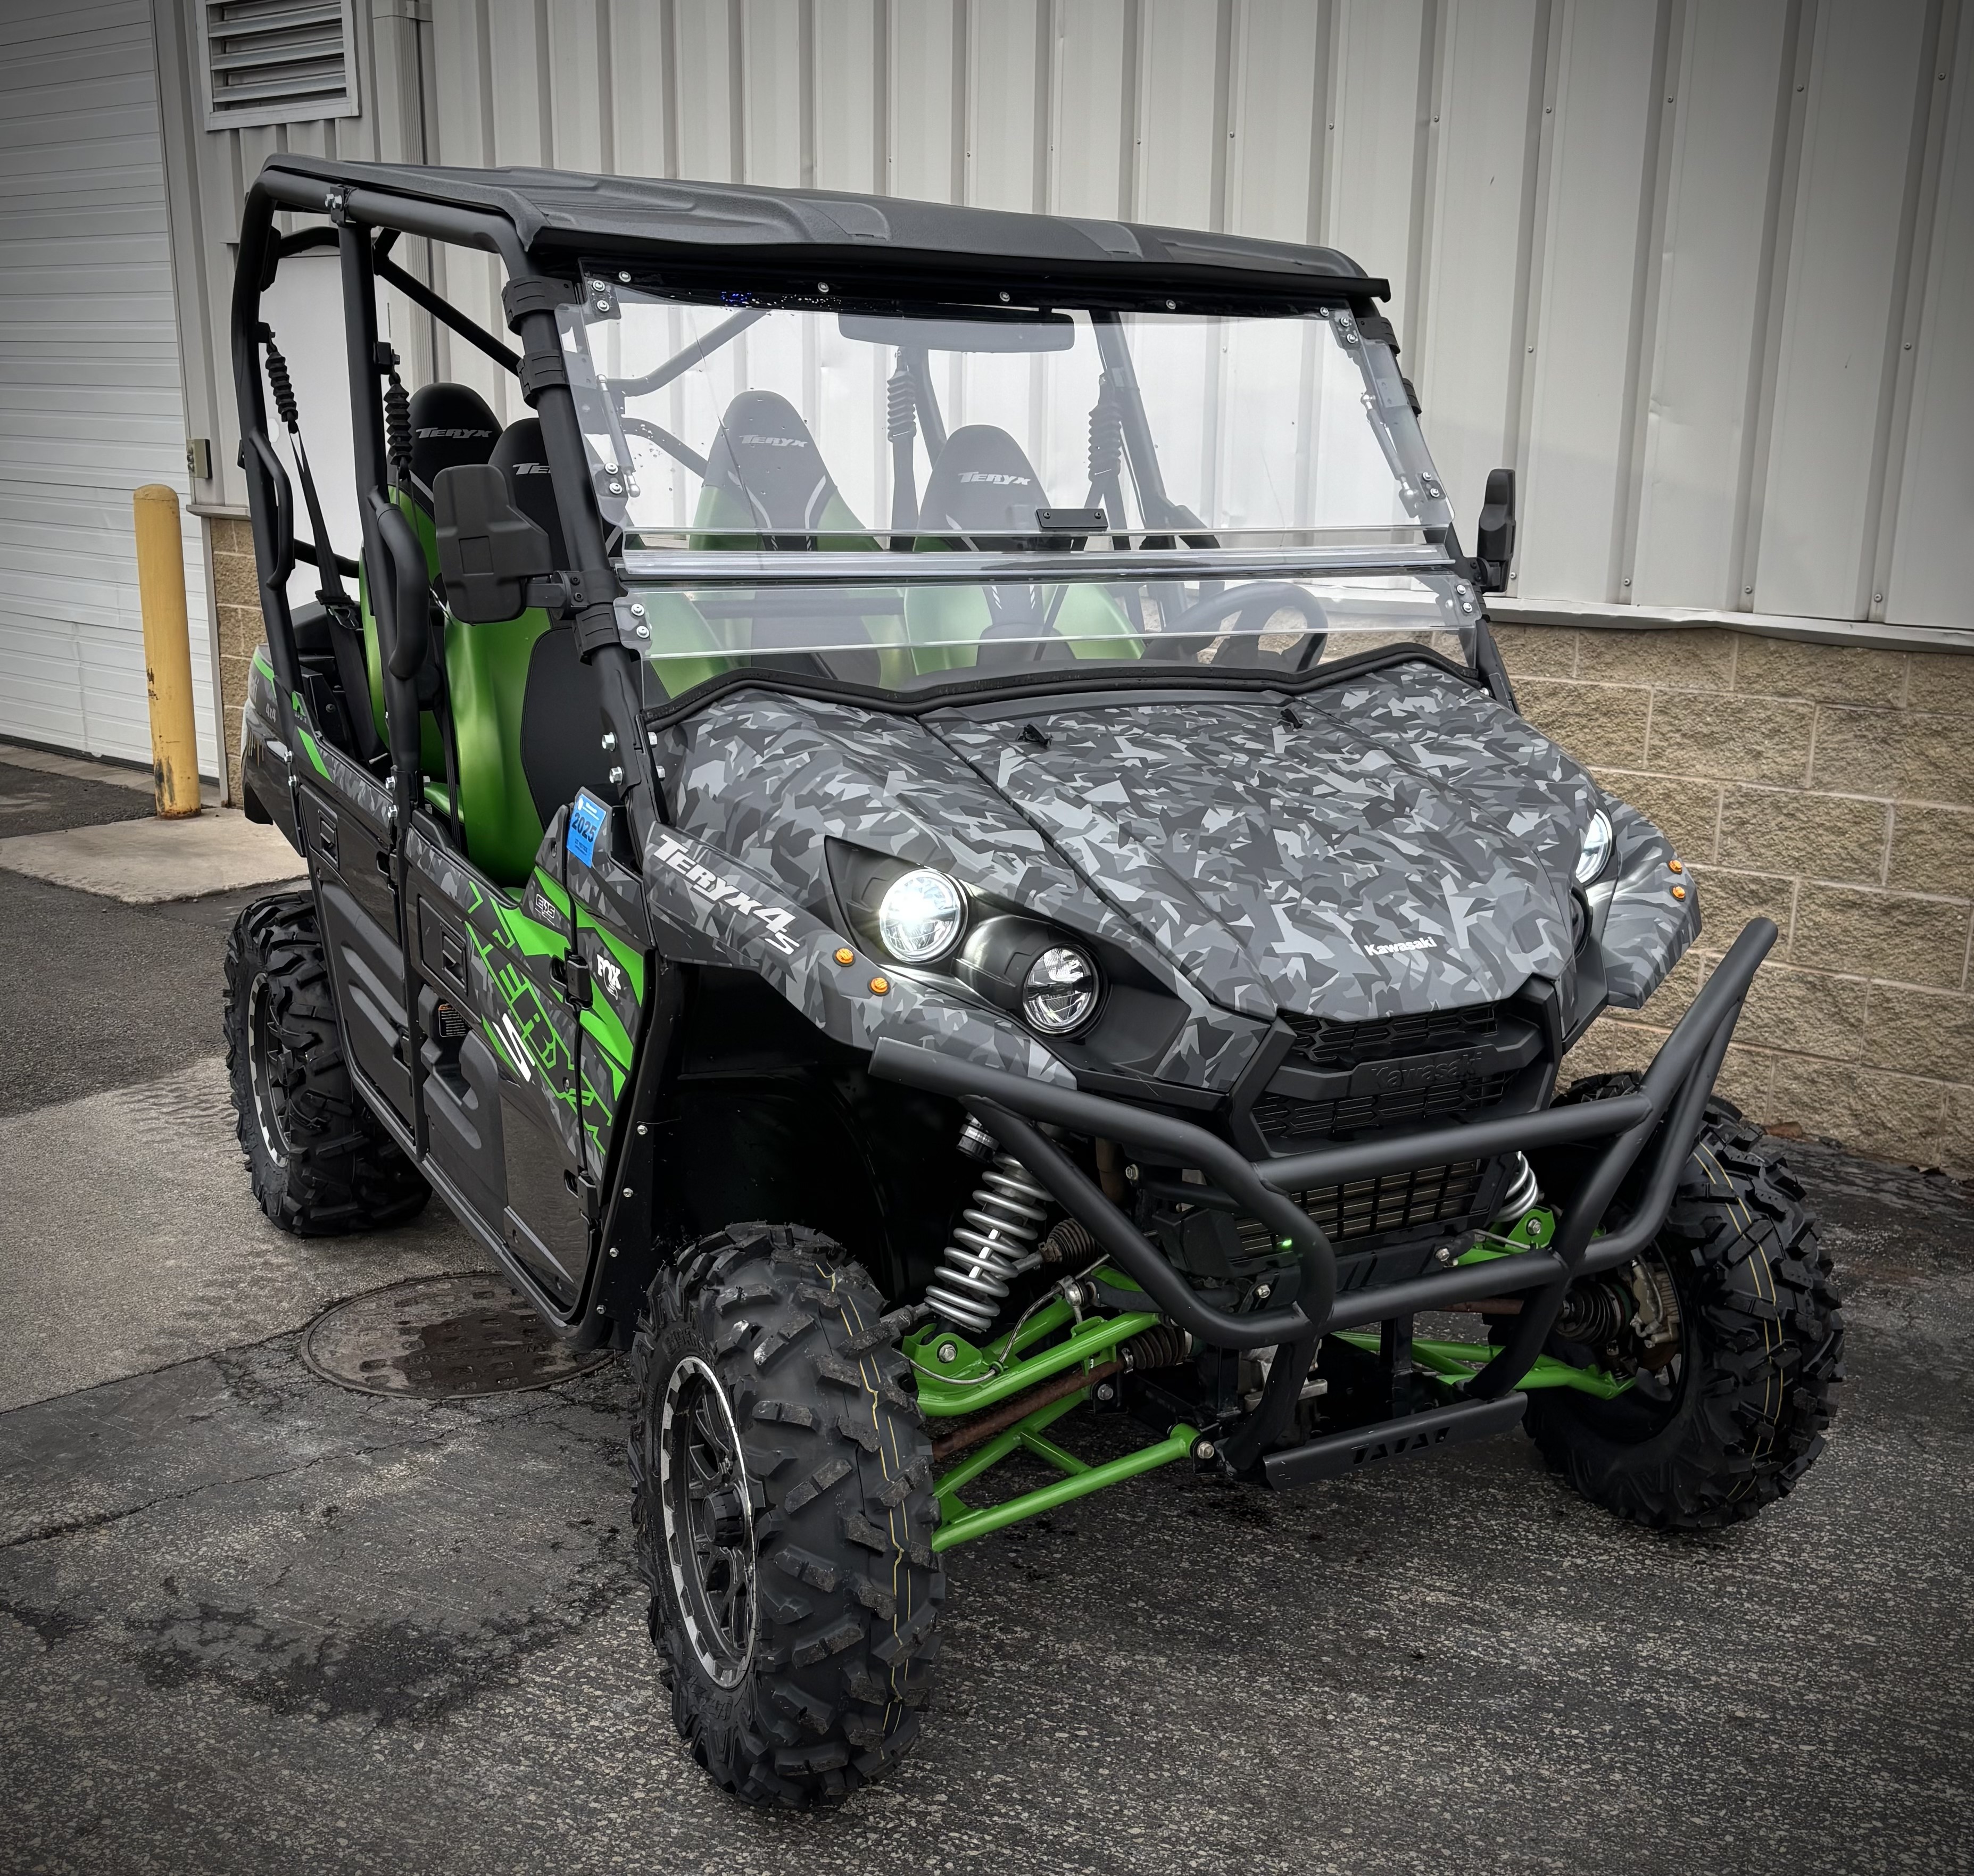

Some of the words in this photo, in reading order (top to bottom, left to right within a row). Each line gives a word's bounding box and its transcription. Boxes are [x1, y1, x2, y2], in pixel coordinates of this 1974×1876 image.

[416, 427, 493, 439] TERYX
[958, 471, 1031, 485] TERYX
[571, 812, 597, 843] 2025
[1364, 936, 1438, 956] Kawasaki
[596, 953, 621, 1000] FOX
